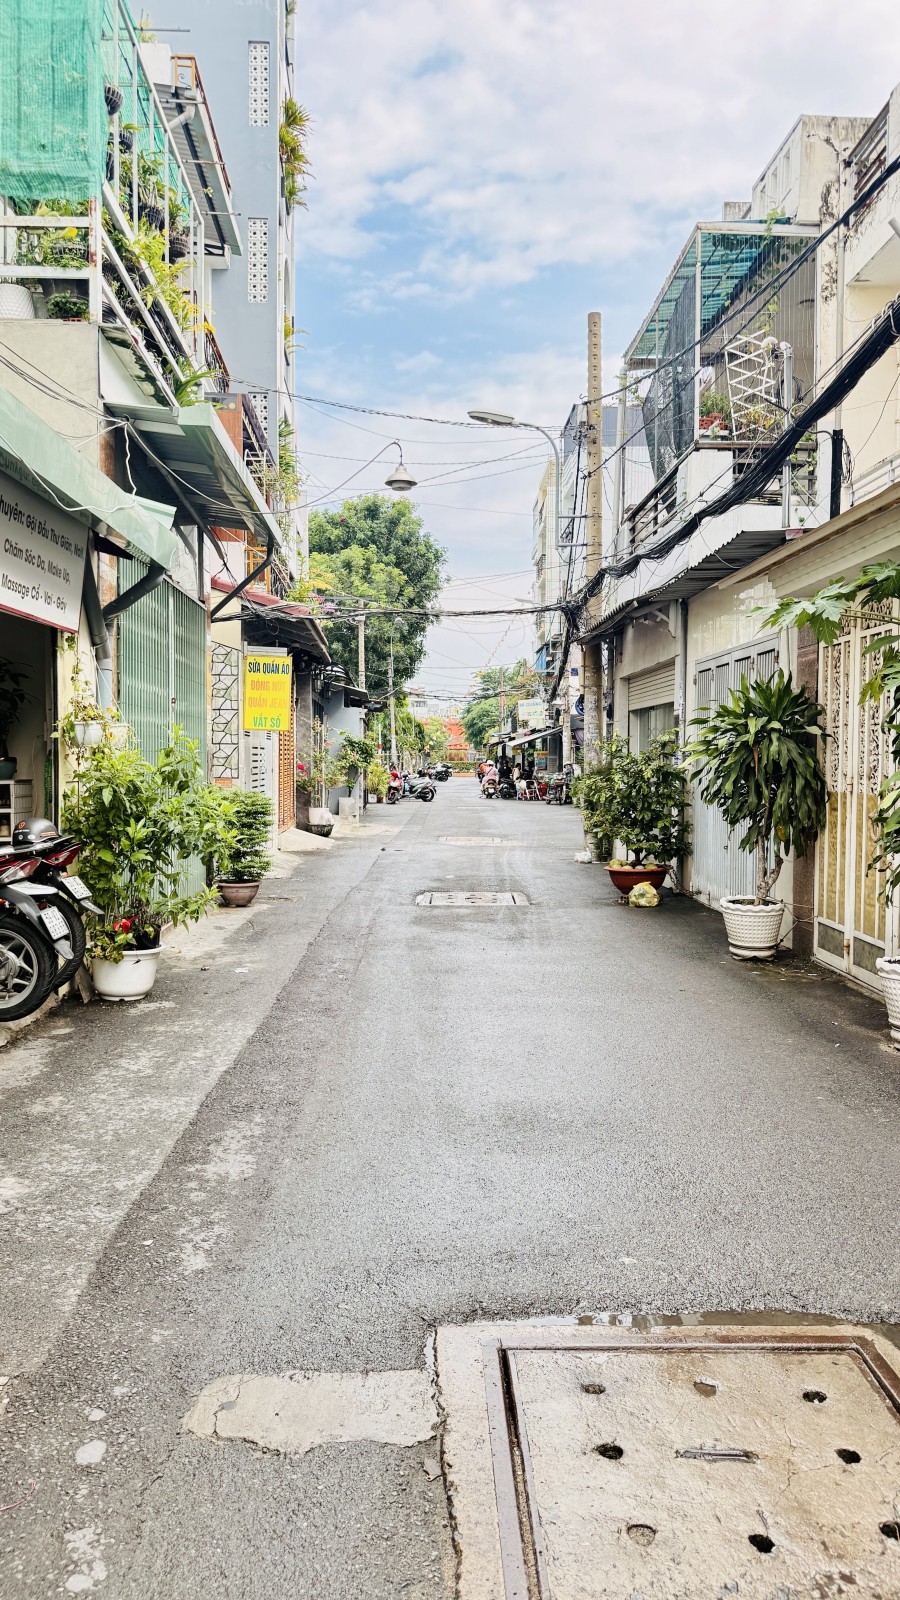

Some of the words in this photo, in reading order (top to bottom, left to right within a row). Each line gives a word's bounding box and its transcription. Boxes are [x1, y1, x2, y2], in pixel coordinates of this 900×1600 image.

[0, 494, 25, 525] huyên:
[26, 514, 38, 535] Gội
[50, 528, 60, 545] Thư
[4, 538, 24, 560] Chăm
[24, 549, 36, 566] Sóc
[37, 554, 47, 574] Da,
[47, 560, 62, 578] Make
[1, 573, 30, 600] Massage
[31, 584, 40, 601] Cổ
[44, 591, 54, 606] Vai
[248, 658, 261, 673] SỬA
[281, 661, 290, 675] ÁO
[250, 678, 270, 691] ĐÓNG
[269, 697, 288, 710] JEAN
